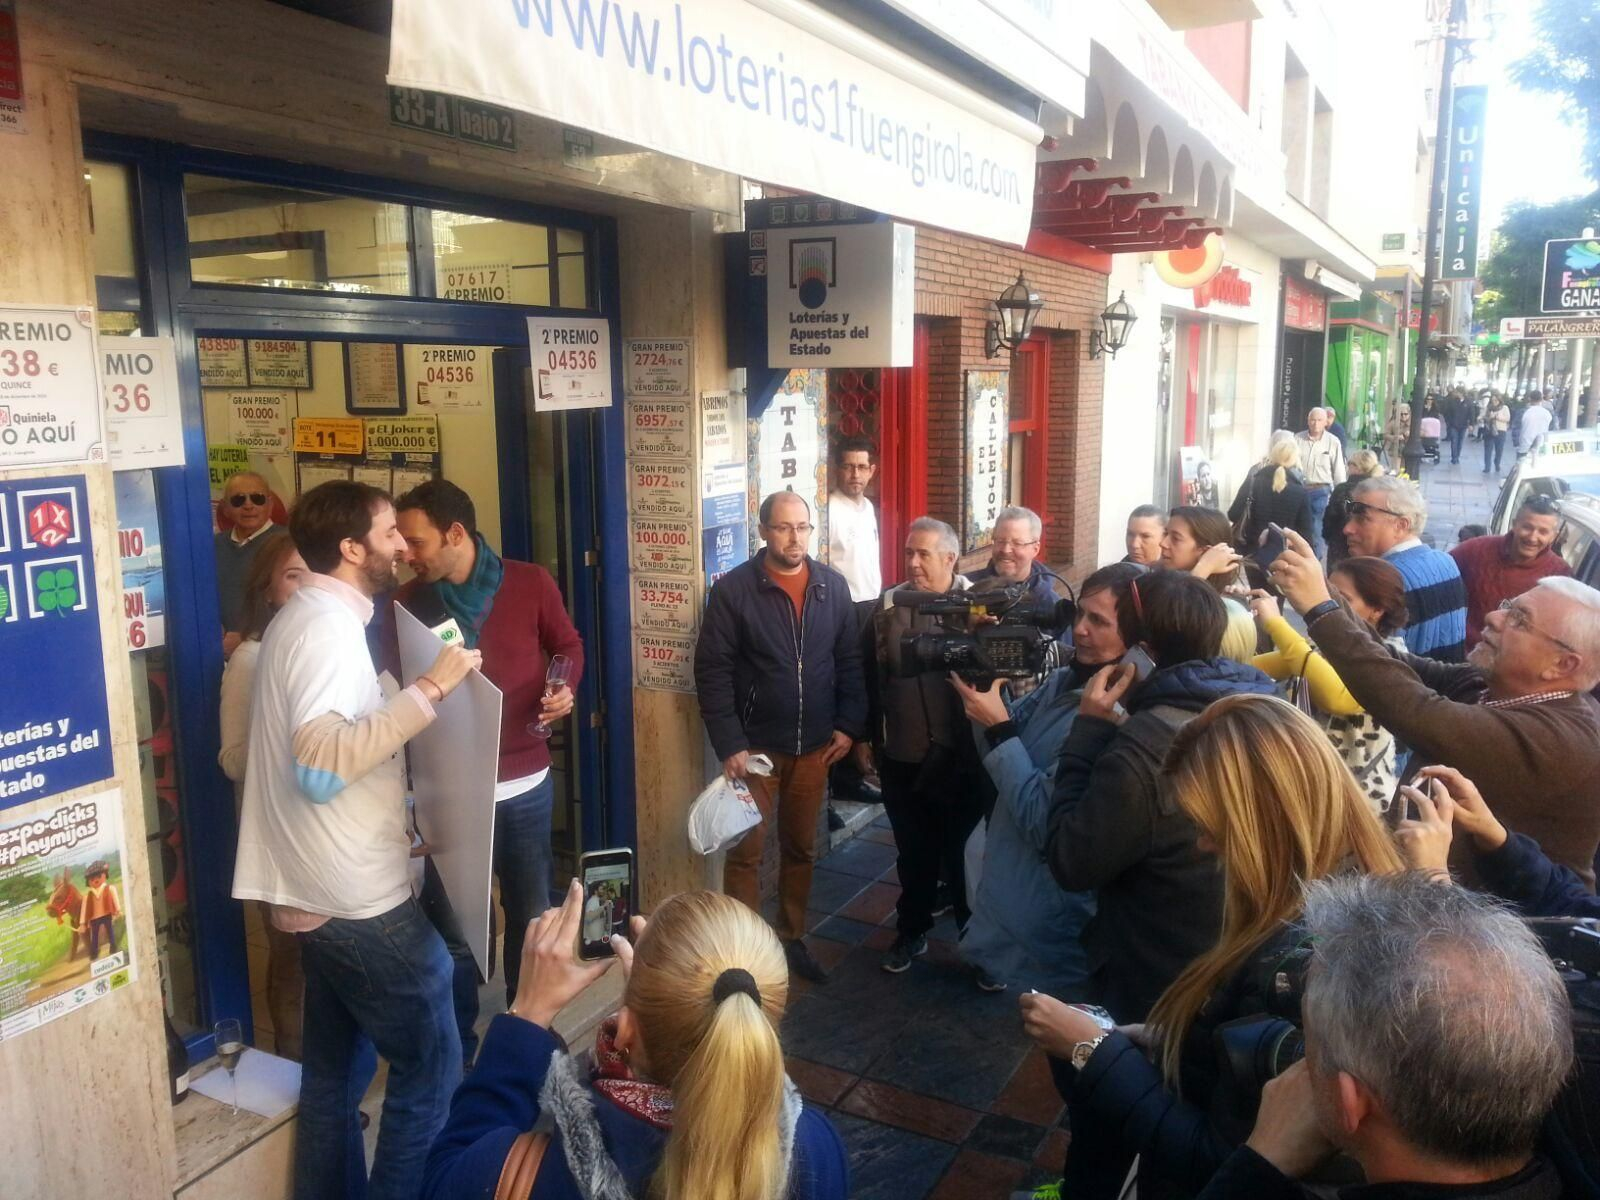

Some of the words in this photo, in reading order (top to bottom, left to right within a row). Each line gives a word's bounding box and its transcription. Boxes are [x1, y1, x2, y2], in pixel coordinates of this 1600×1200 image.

[459, 104, 499, 140] bajo
[501, 115, 513, 144] 2
[1452, 125, 1478, 271] Unicaja
[448, 271, 497, 286] 07617
[455, 286, 505, 301] PREMIO
[789, 309, 838, 324] Loterías
[842, 312, 850, 325] y
[554, 328, 599, 345] PREMIO
[790, 327, 846, 342] Apuestas
[850, 325, 869, 339] del
[632, 343, 652, 351] GRAN
[655, 343, 684, 351] PREMIO
[789, 343, 832, 356] Estado
[432, 349, 476, 362] PREMIO
[549, 350, 597, 370] 04536
[48, 362, 59, 377] €
[105, 353, 154, 376] MIO
[255, 368, 285, 377] VENDIDO
[427, 366, 474, 383] 04536
[1, 381, 32, 390] QUINCE
[104, 383, 151, 413] 36
[233, 396, 253, 405] GRAN
[254, 396, 280, 405] PREMIO
[237, 407, 274, 419] 100.000
[633, 405, 654, 413] GRAN
[656, 405, 684, 413] PREMIO
[13, 411, 57, 425] Quiniela
[26, 421, 76, 444] AQUÍ
[316, 431, 336, 448] 11
[367, 436, 425, 448] 1.000.000
[428, 436, 437, 448] €
[636, 444, 665, 452] VENDIDO
[1552, 442, 1576, 454] TAXI
[635, 465, 655, 473] GRAN
[658, 465, 686, 474] PREMIO
[636, 522, 657, 531] GRAN
[659, 522, 687, 532] PREMIO
[635, 531, 686, 545] 100.000
[639, 561, 669, 569] VENDIDO
[638, 580, 658, 589] GRAN
[660, 582, 689, 591] PREMIO
[640, 590, 684, 604] 33.754
[641, 618, 670, 627] VENDIDO
[640, 637, 660, 646] GRAN
[662, 639, 690, 649] PREMIO
[642, 675, 672, 685] VENDIDO
[57, 717, 70, 738] y
[0, 743, 67, 773] uestas
[70, 729, 100, 754] del
